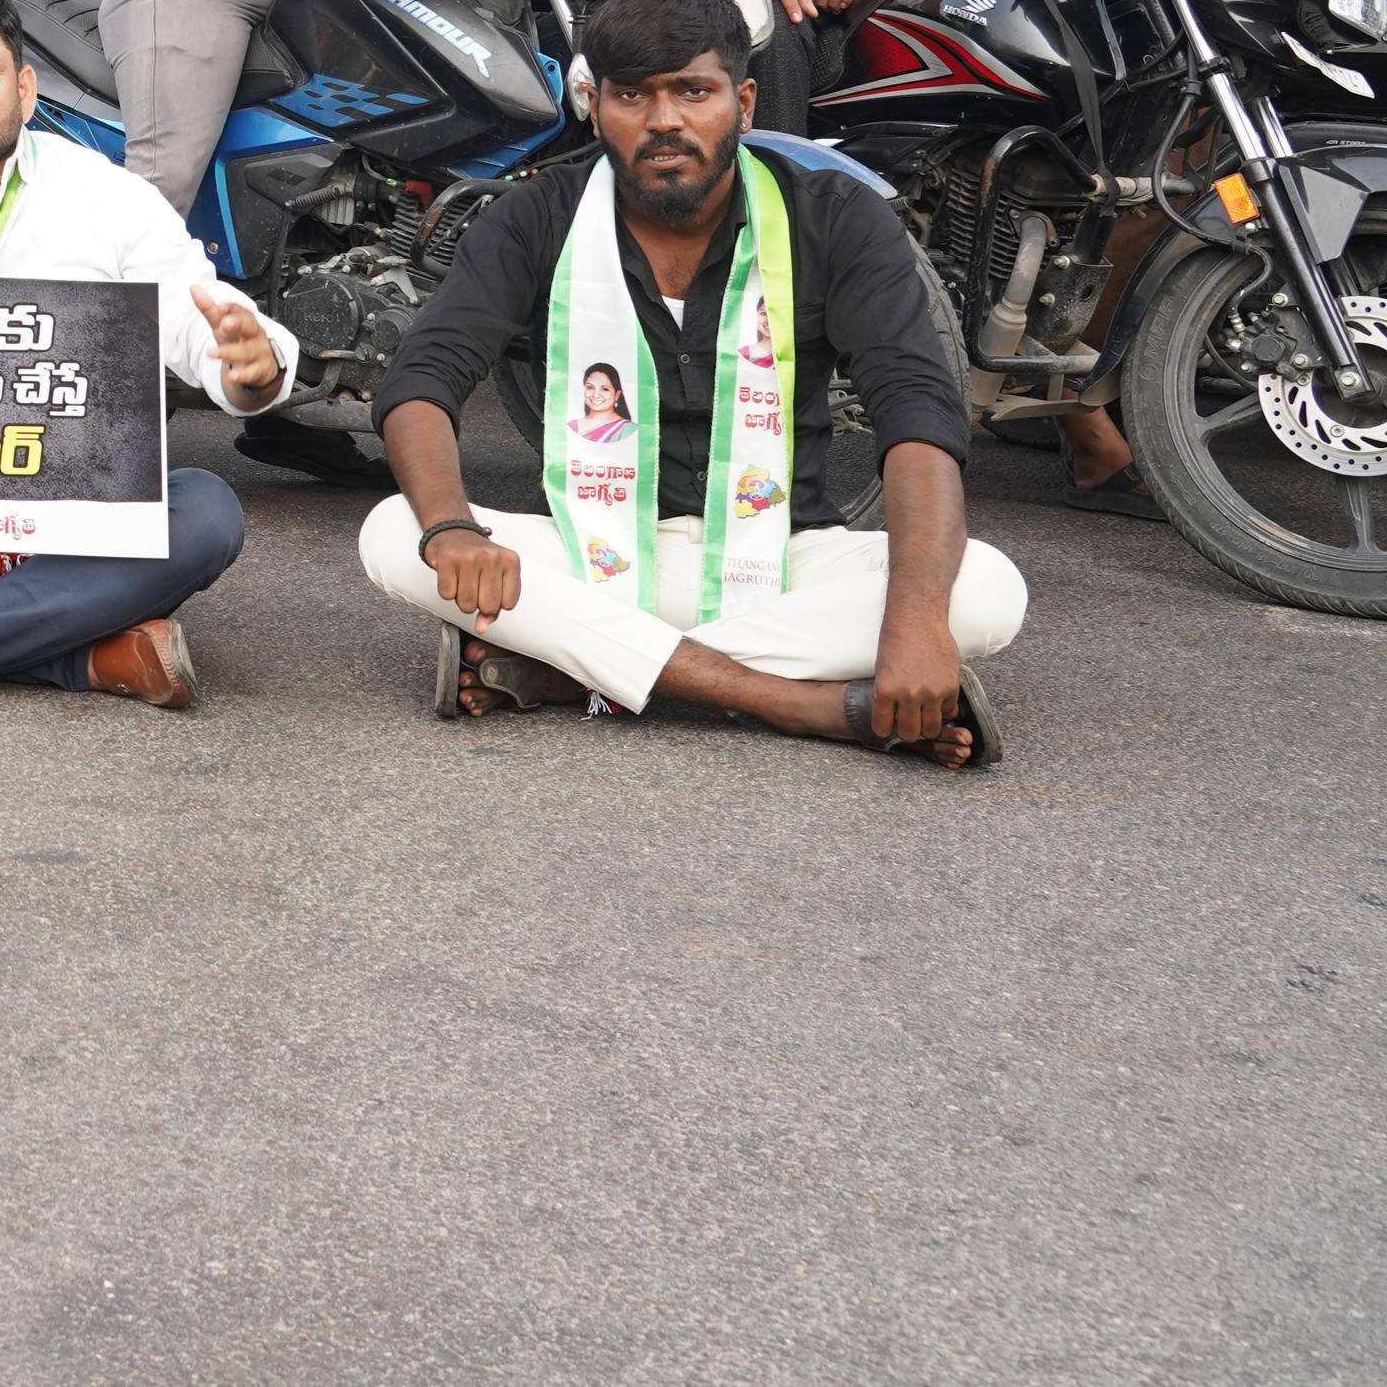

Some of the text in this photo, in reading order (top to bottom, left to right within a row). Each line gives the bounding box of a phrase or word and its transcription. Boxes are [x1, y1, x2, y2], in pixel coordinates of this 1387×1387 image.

[943, 4, 987, 26] HONDA
[12, 361, 89, 418] చేస్తే
[570, 460, 636, 480] తెలంగాణ
[577, 483, 627, 506] జాగృతి
